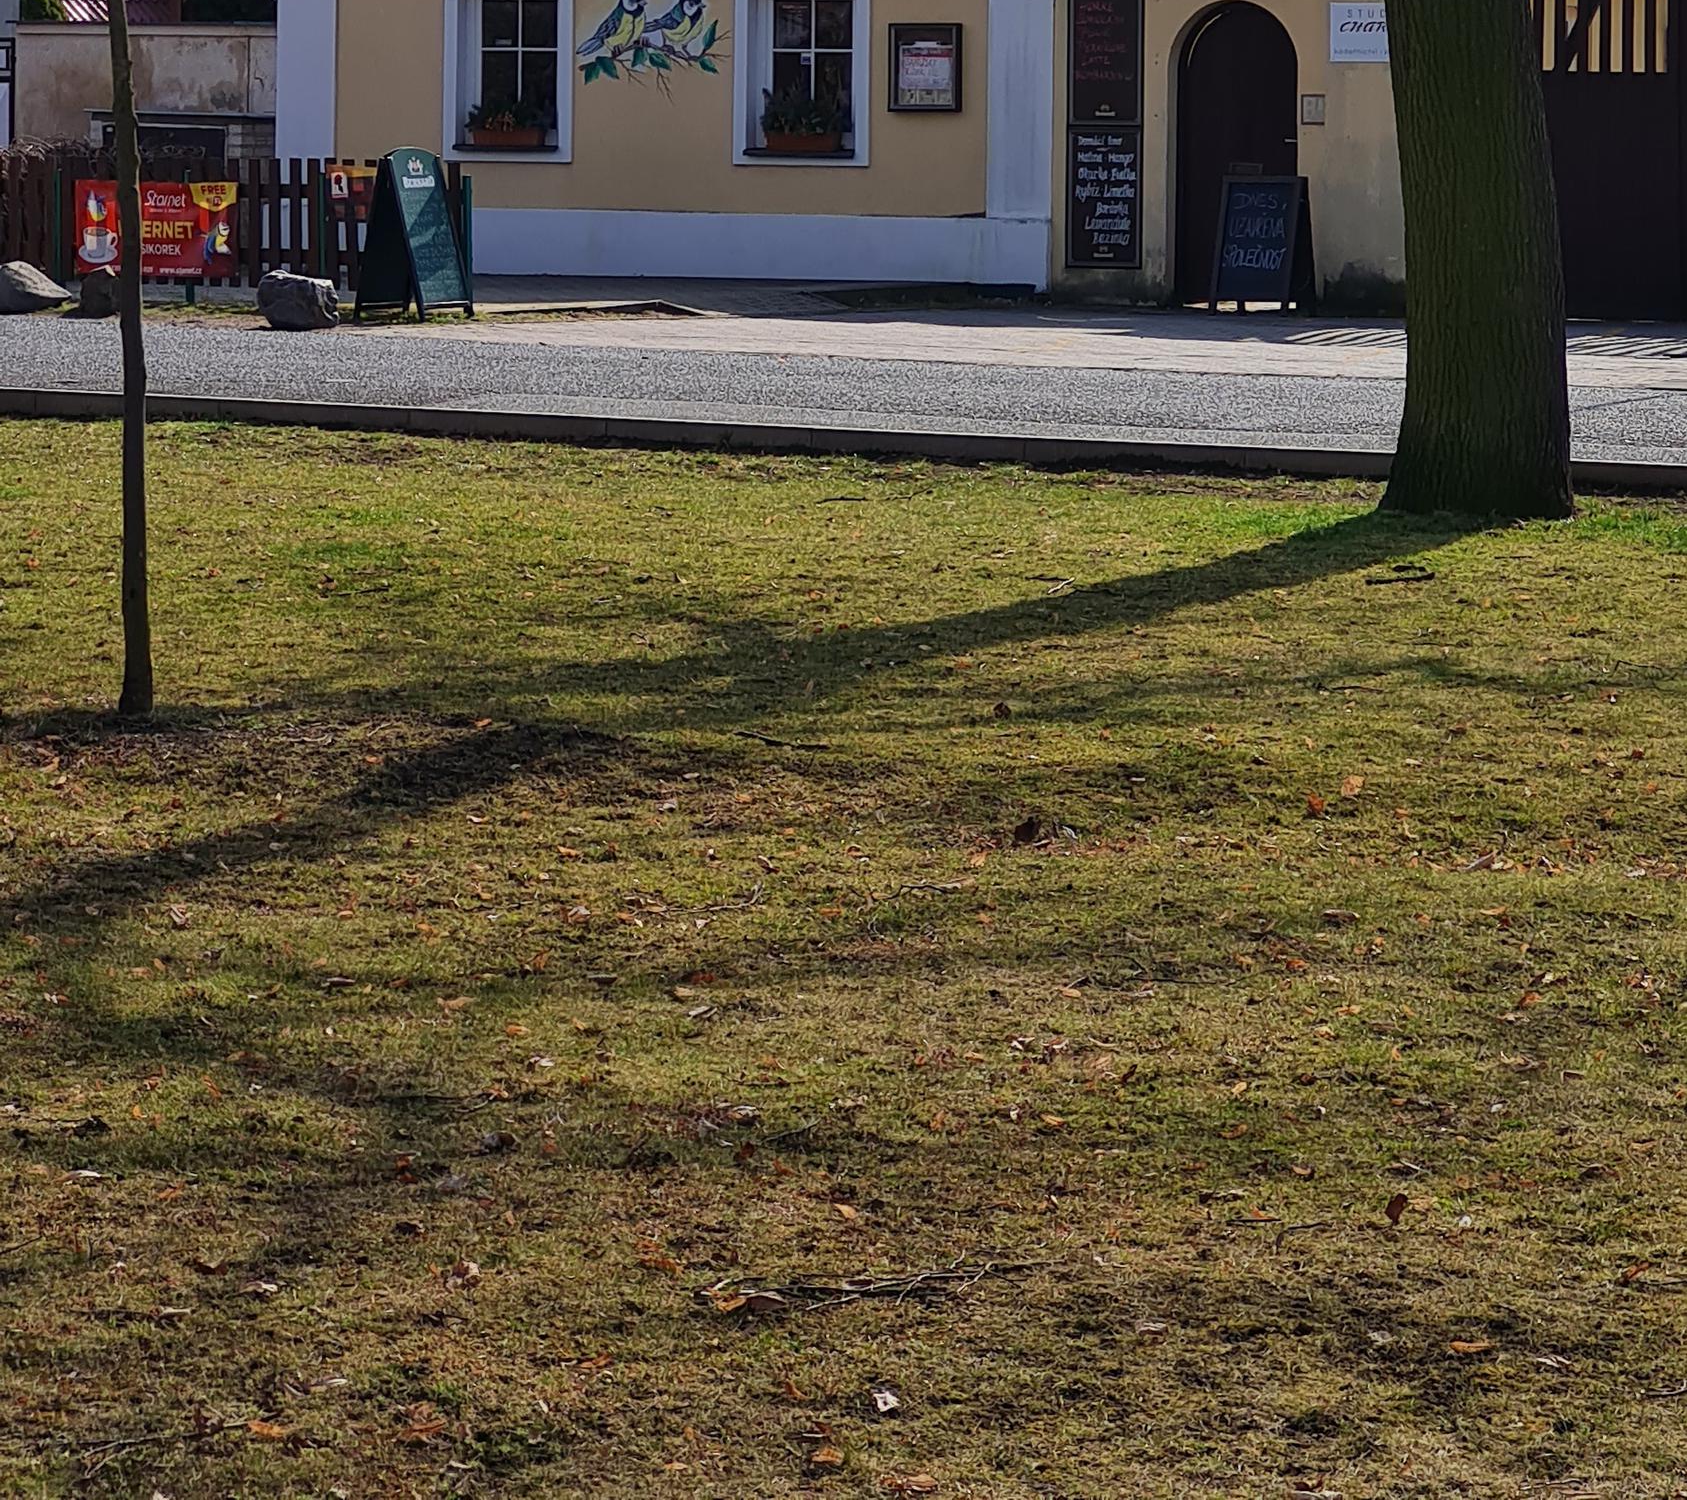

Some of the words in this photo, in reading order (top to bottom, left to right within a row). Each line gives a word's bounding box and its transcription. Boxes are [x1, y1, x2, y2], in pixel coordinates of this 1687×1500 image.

[1346, 8, 1386, 19] STUD
[1339, 21, 1386, 33] CHAR
[200, 184, 227, 196] FREE
[117, 219, 195, 240] IERNET
